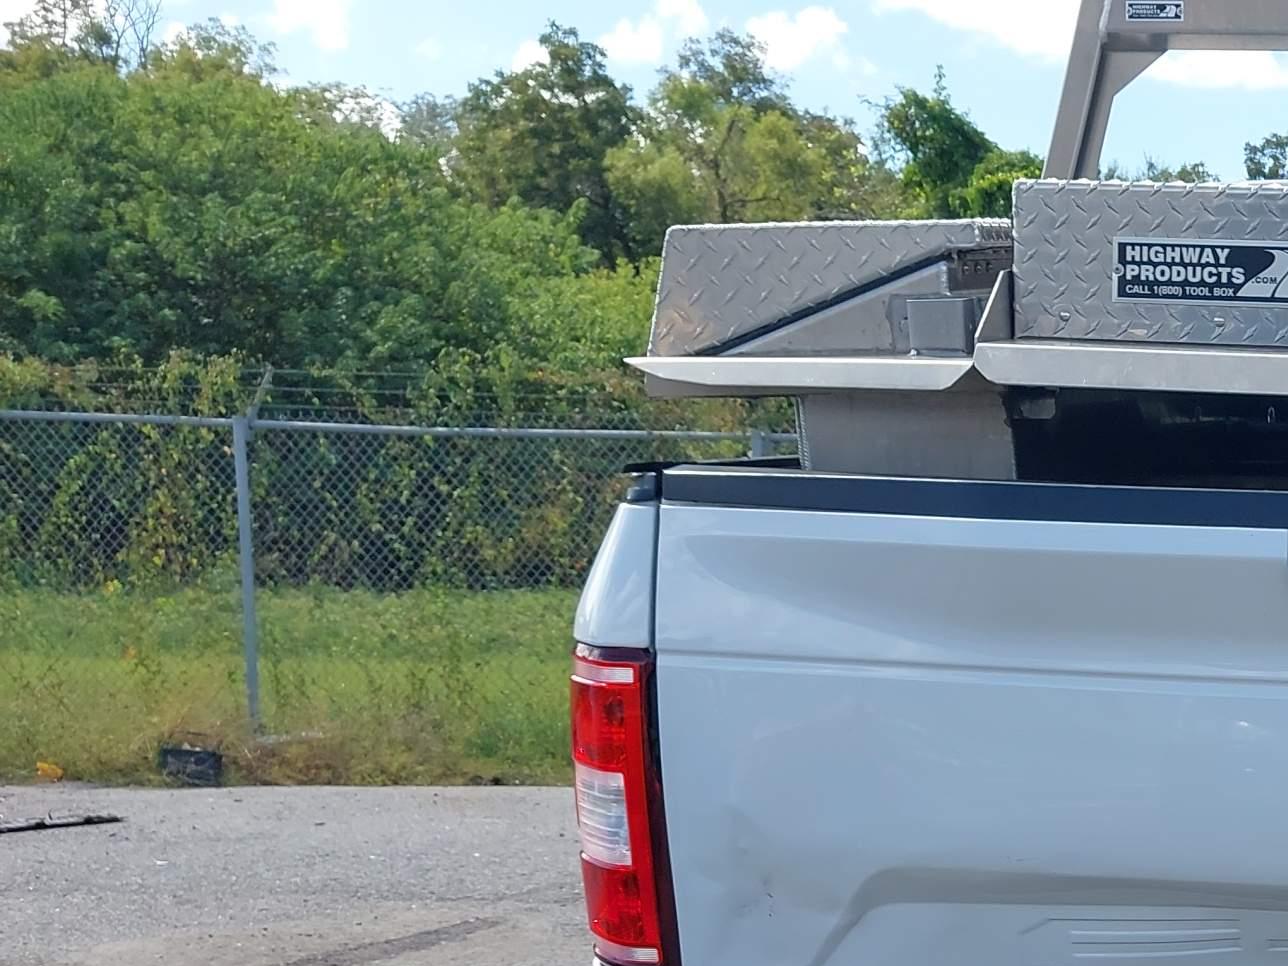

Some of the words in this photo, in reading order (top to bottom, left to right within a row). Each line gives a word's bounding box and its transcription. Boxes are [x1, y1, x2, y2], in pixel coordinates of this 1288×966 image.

[1125, 245, 1231, 264] HIGHWAY
[1125, 264, 1245, 284] PRODUCTS
[1125, 285, 1152, 294] CALL
[1153, 286, 1183, 296] 1(800)
[1185, 287, 1211, 296] TOOL
[1213, 288, 1235, 296] BOX
